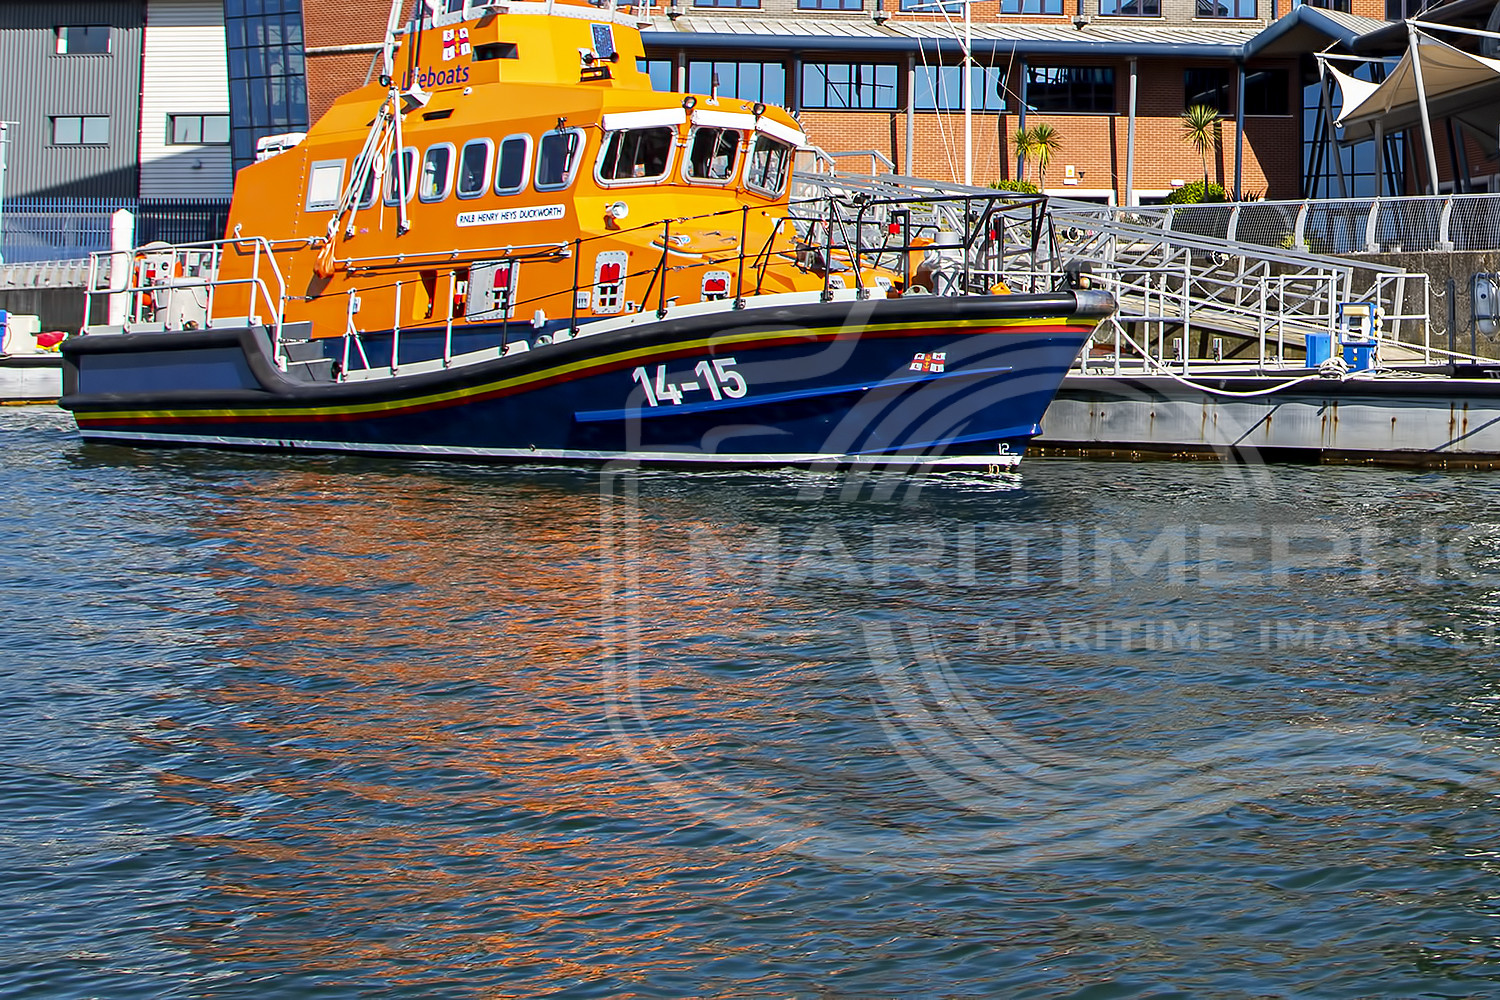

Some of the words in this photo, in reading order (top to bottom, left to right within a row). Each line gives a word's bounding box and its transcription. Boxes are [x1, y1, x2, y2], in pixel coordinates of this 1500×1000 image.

[477, 212, 499, 222] HENRY
[519, 207, 563, 219] DUCKWORTH
[632, 357, 748, 407] 14-15
[998, 443, 1010, 455] 12
